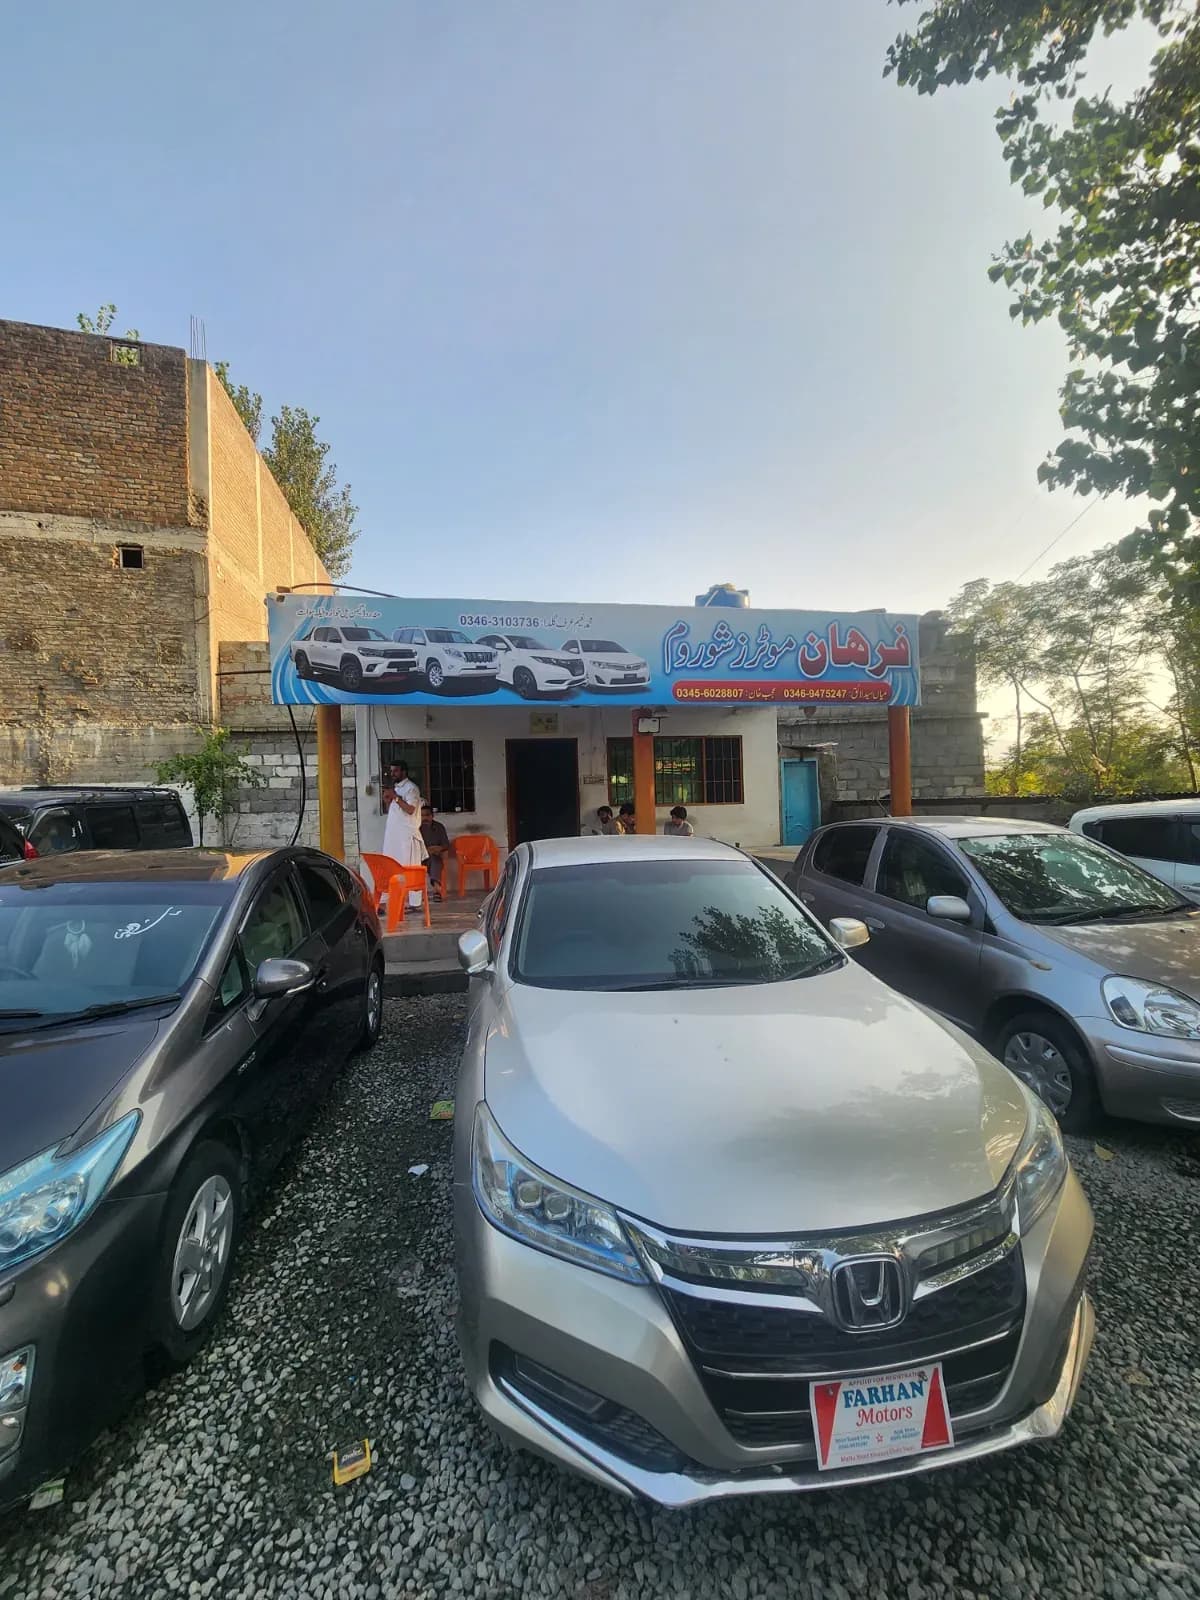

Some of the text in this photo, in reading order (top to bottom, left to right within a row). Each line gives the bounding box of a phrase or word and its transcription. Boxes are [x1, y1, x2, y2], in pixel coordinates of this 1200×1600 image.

[460, 615, 539, 628] 0346-3103736
[676, 688, 744, 698] 0345-6028807
[783, 688, 847, 699] 0346-9475247
[843, 1380, 926, 1409] FARHAN
[856, 1405, 913, 1427] Motors
